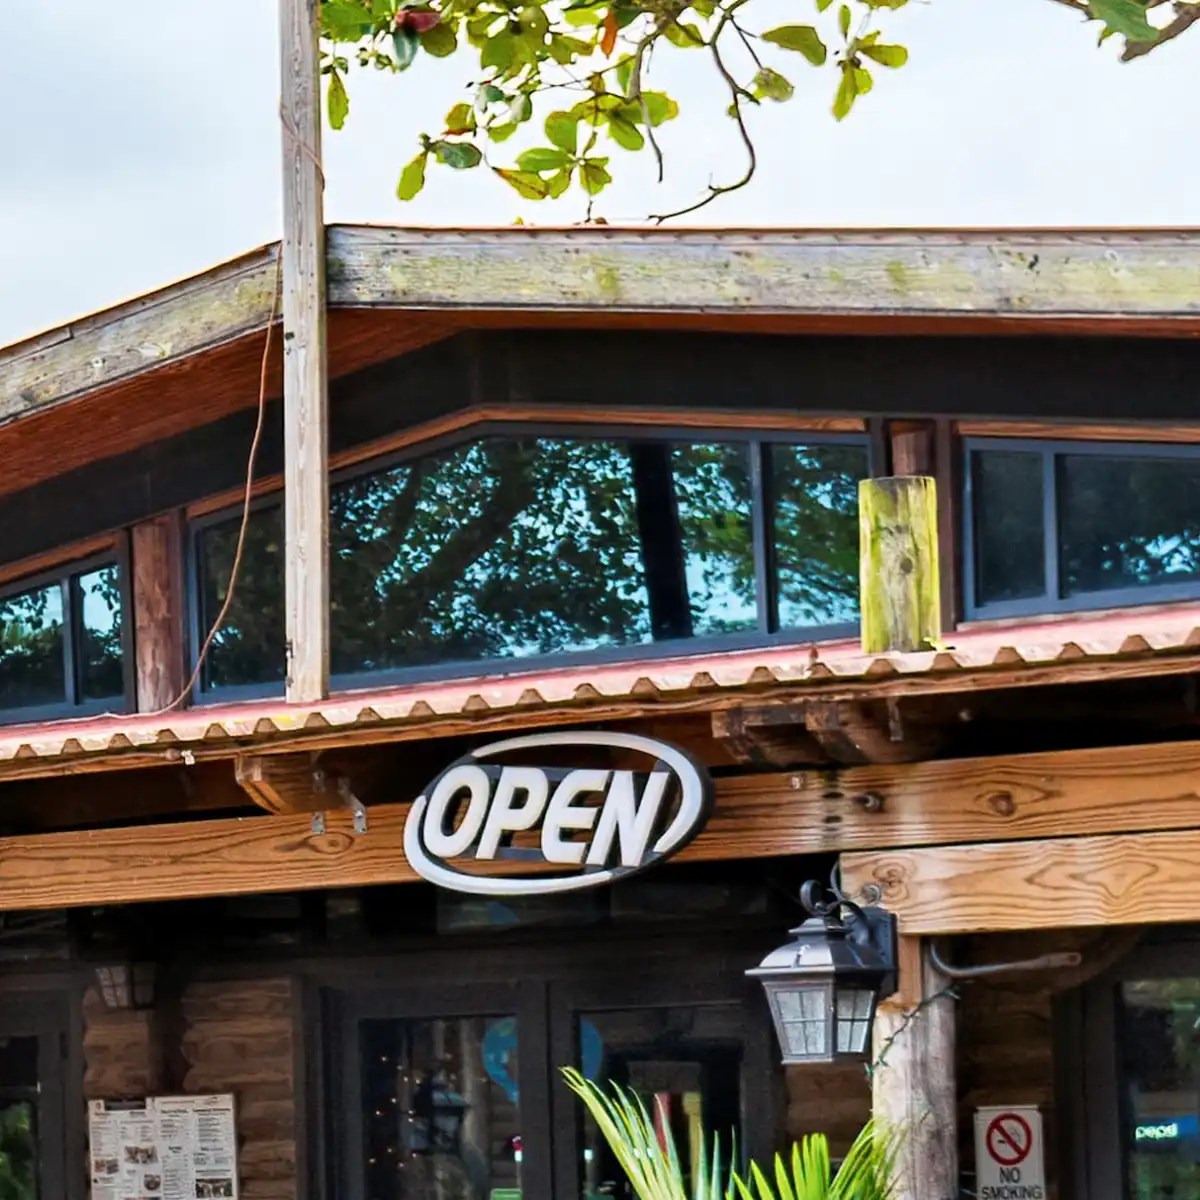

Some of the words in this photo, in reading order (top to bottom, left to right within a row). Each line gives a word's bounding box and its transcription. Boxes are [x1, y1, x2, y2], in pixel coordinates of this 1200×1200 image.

[422, 764, 670, 867] OPEN
[999, 1167, 1021, 1184] NO
[981, 1185, 1043, 1200] SMOKING
